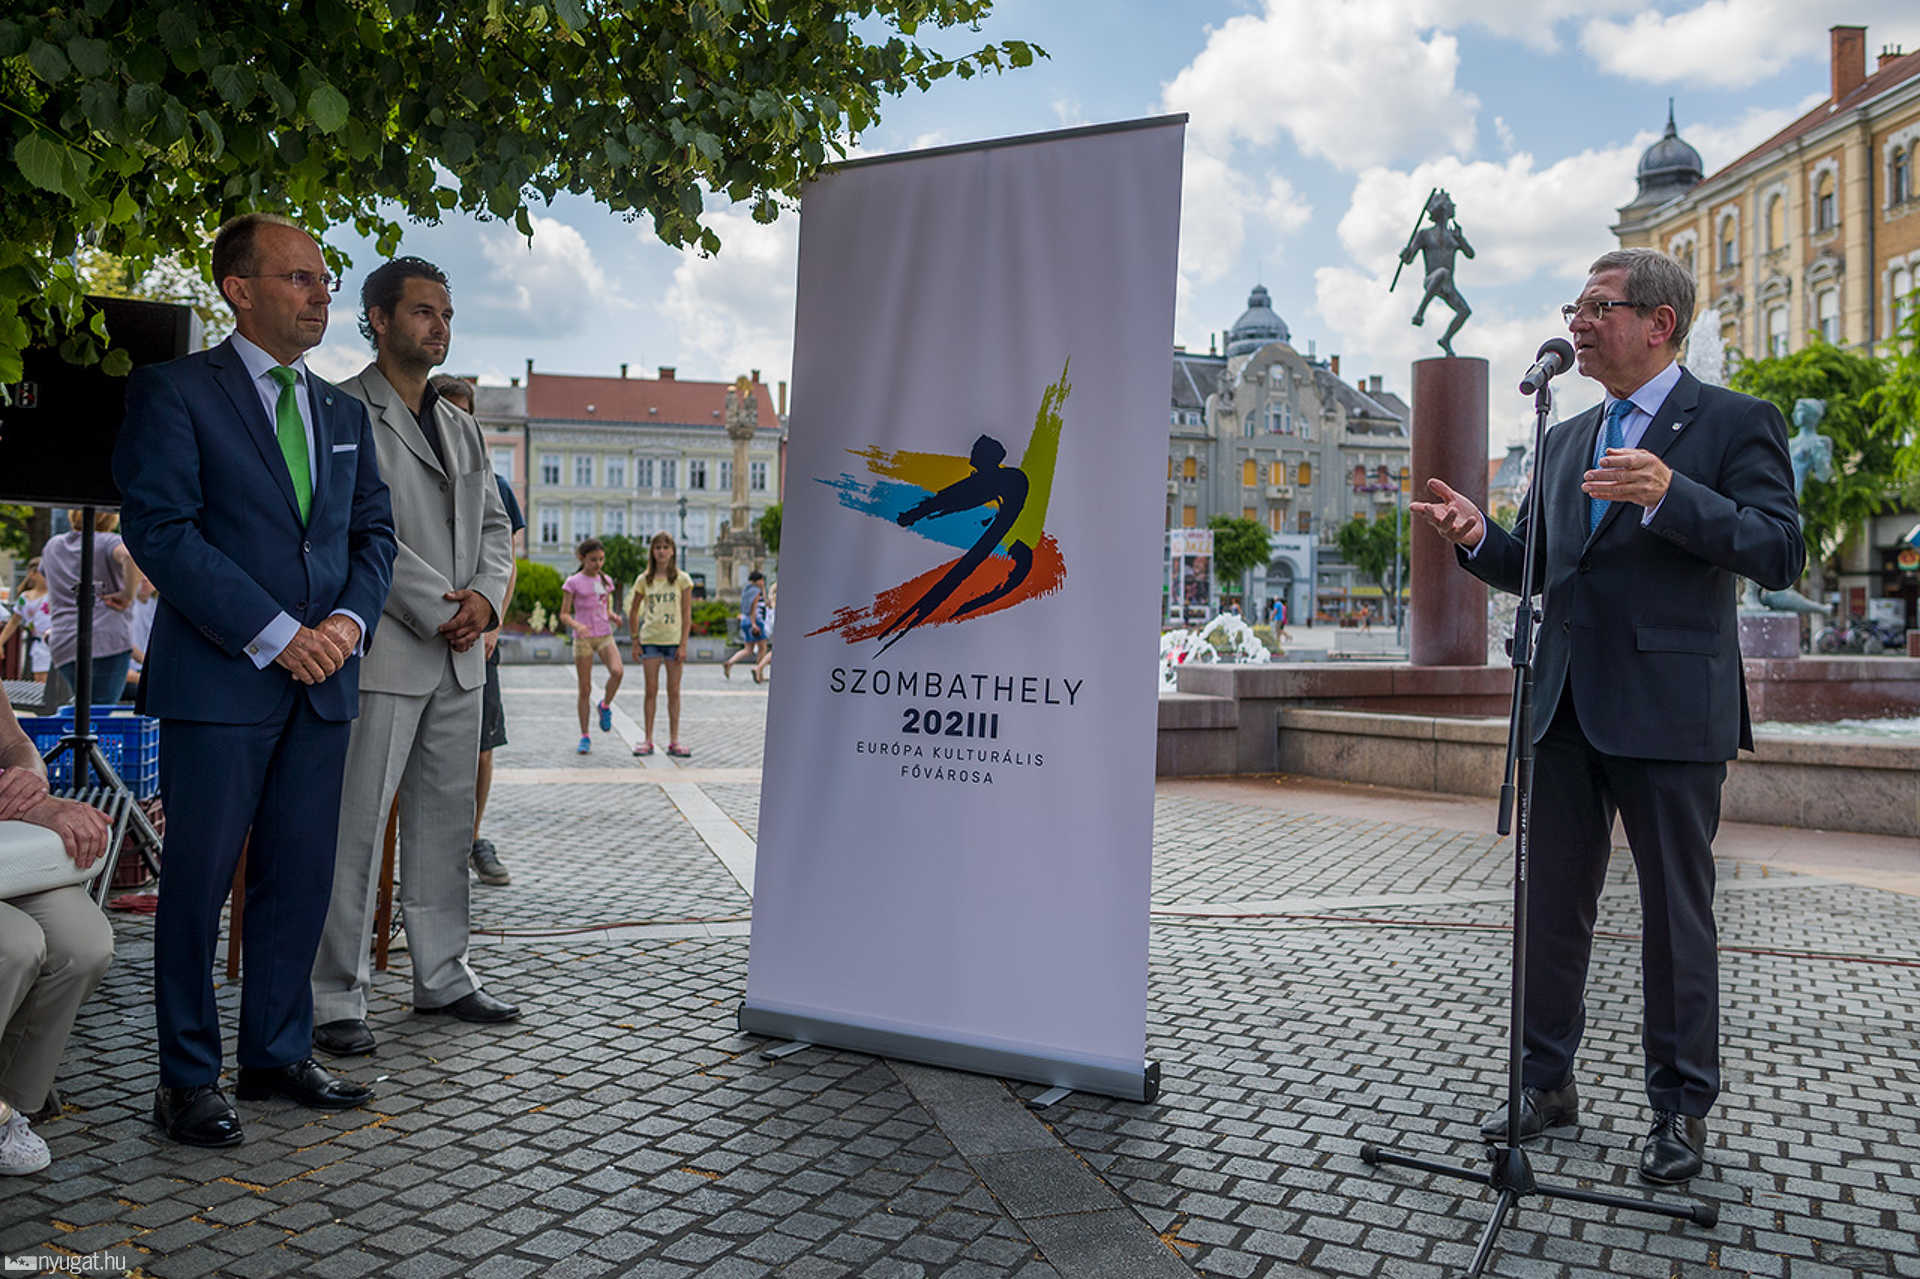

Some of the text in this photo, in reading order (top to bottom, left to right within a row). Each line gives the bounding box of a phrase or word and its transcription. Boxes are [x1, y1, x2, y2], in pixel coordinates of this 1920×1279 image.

[830, 667, 1084, 706] SZOMBATHELY
[901, 708, 999, 740] 202III
[856, 740, 1045, 767] EURÓPA KULTURÁLIS
[900, 764, 994, 785] FŐVÁROSA
